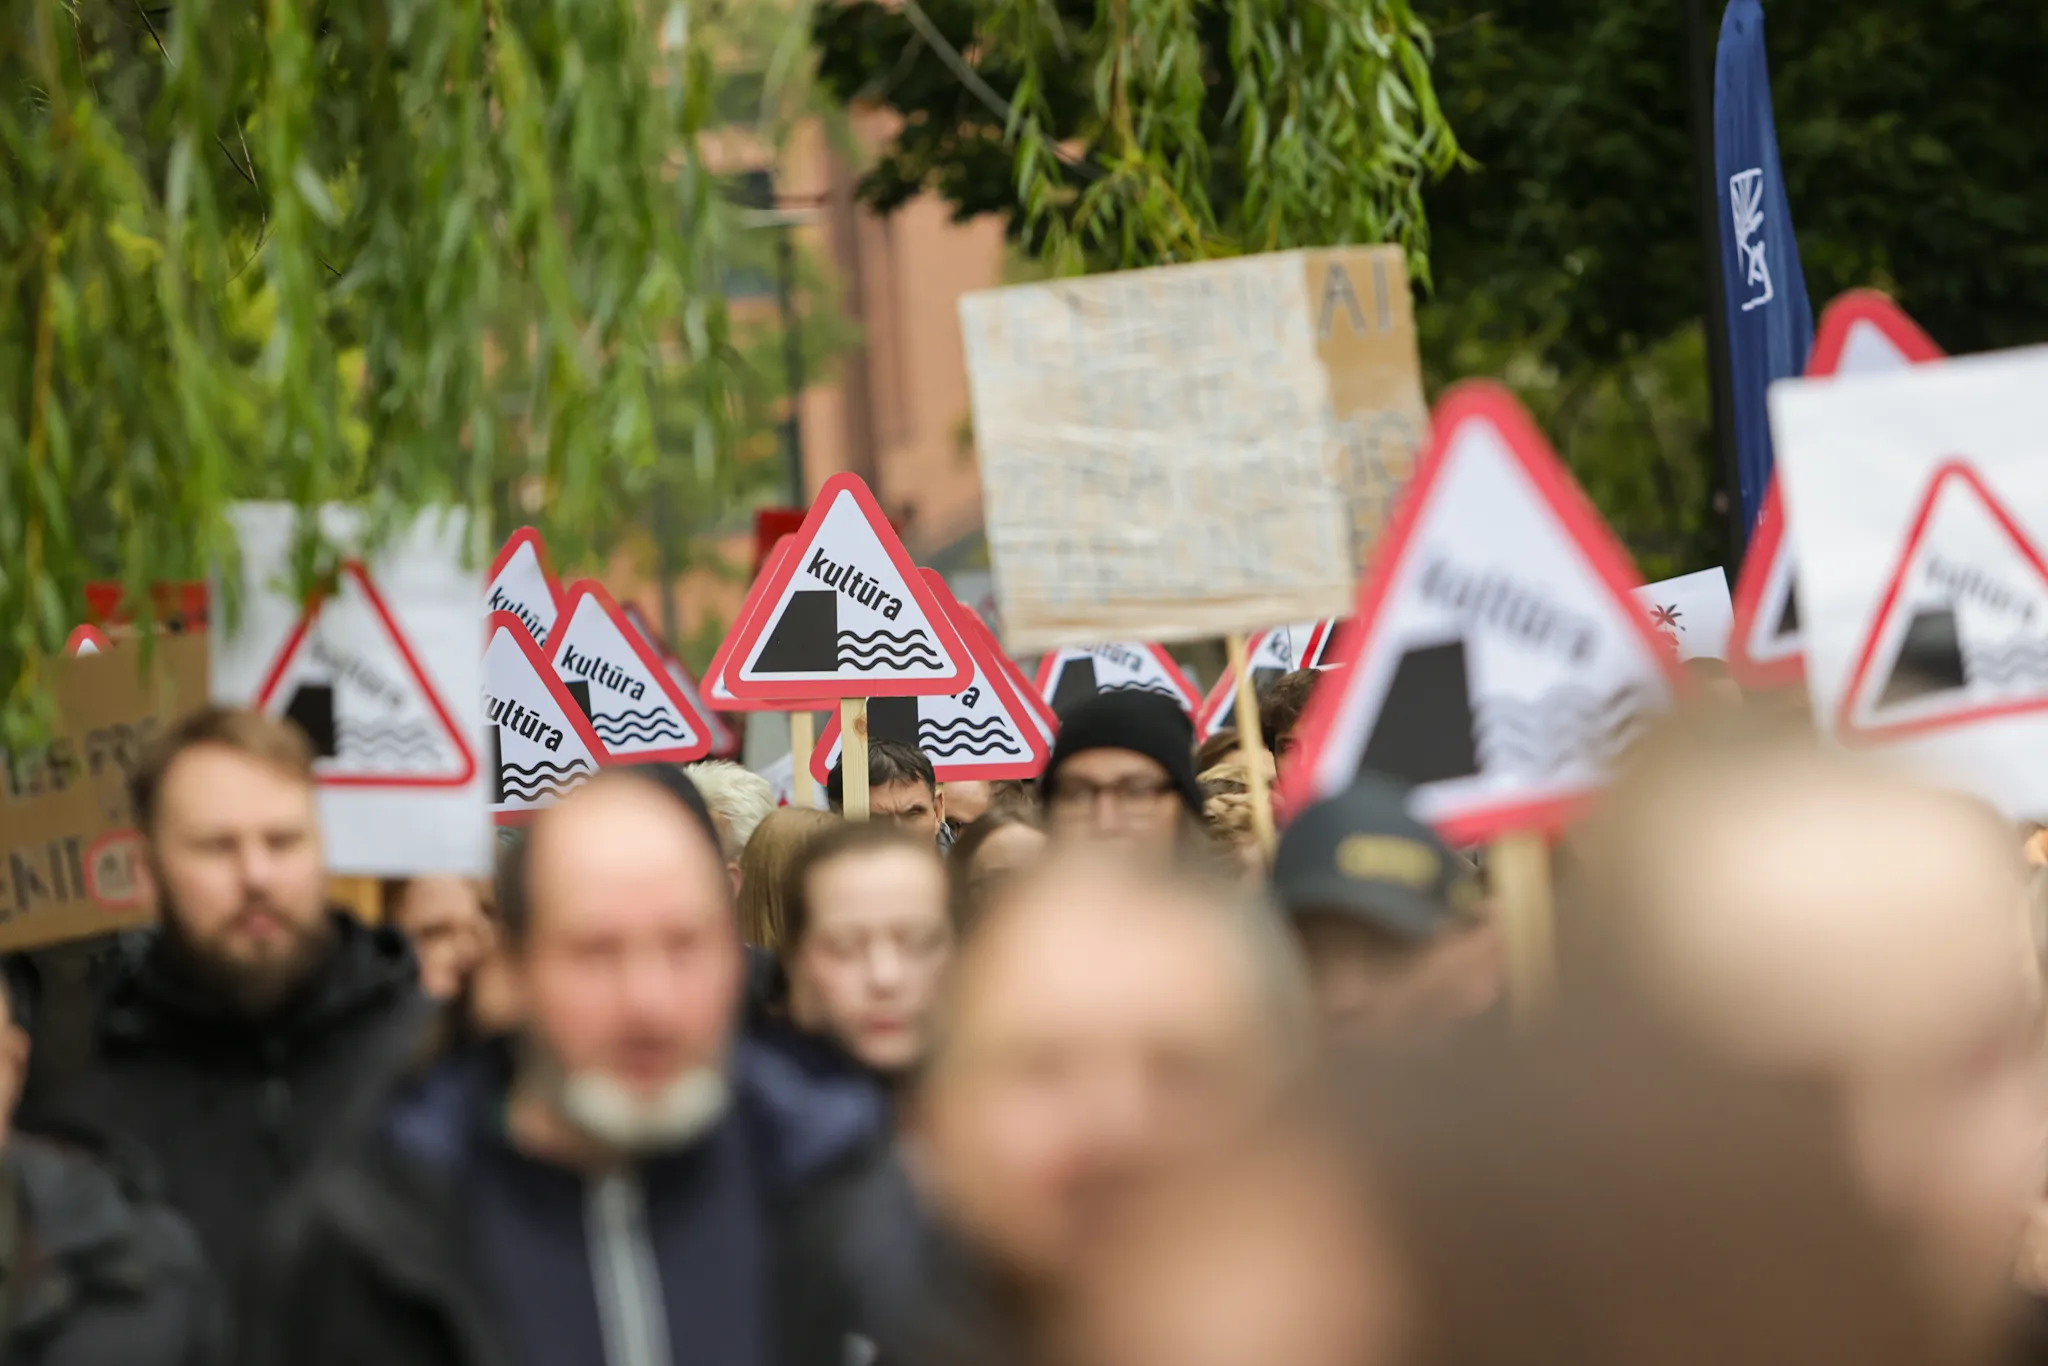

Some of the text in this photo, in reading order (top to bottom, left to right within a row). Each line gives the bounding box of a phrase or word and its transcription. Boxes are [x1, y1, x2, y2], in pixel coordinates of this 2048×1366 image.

[806, 547, 903, 621] kultūra
[561, 645, 645, 701] kultūra
[483, 693, 564, 753] ultūra
